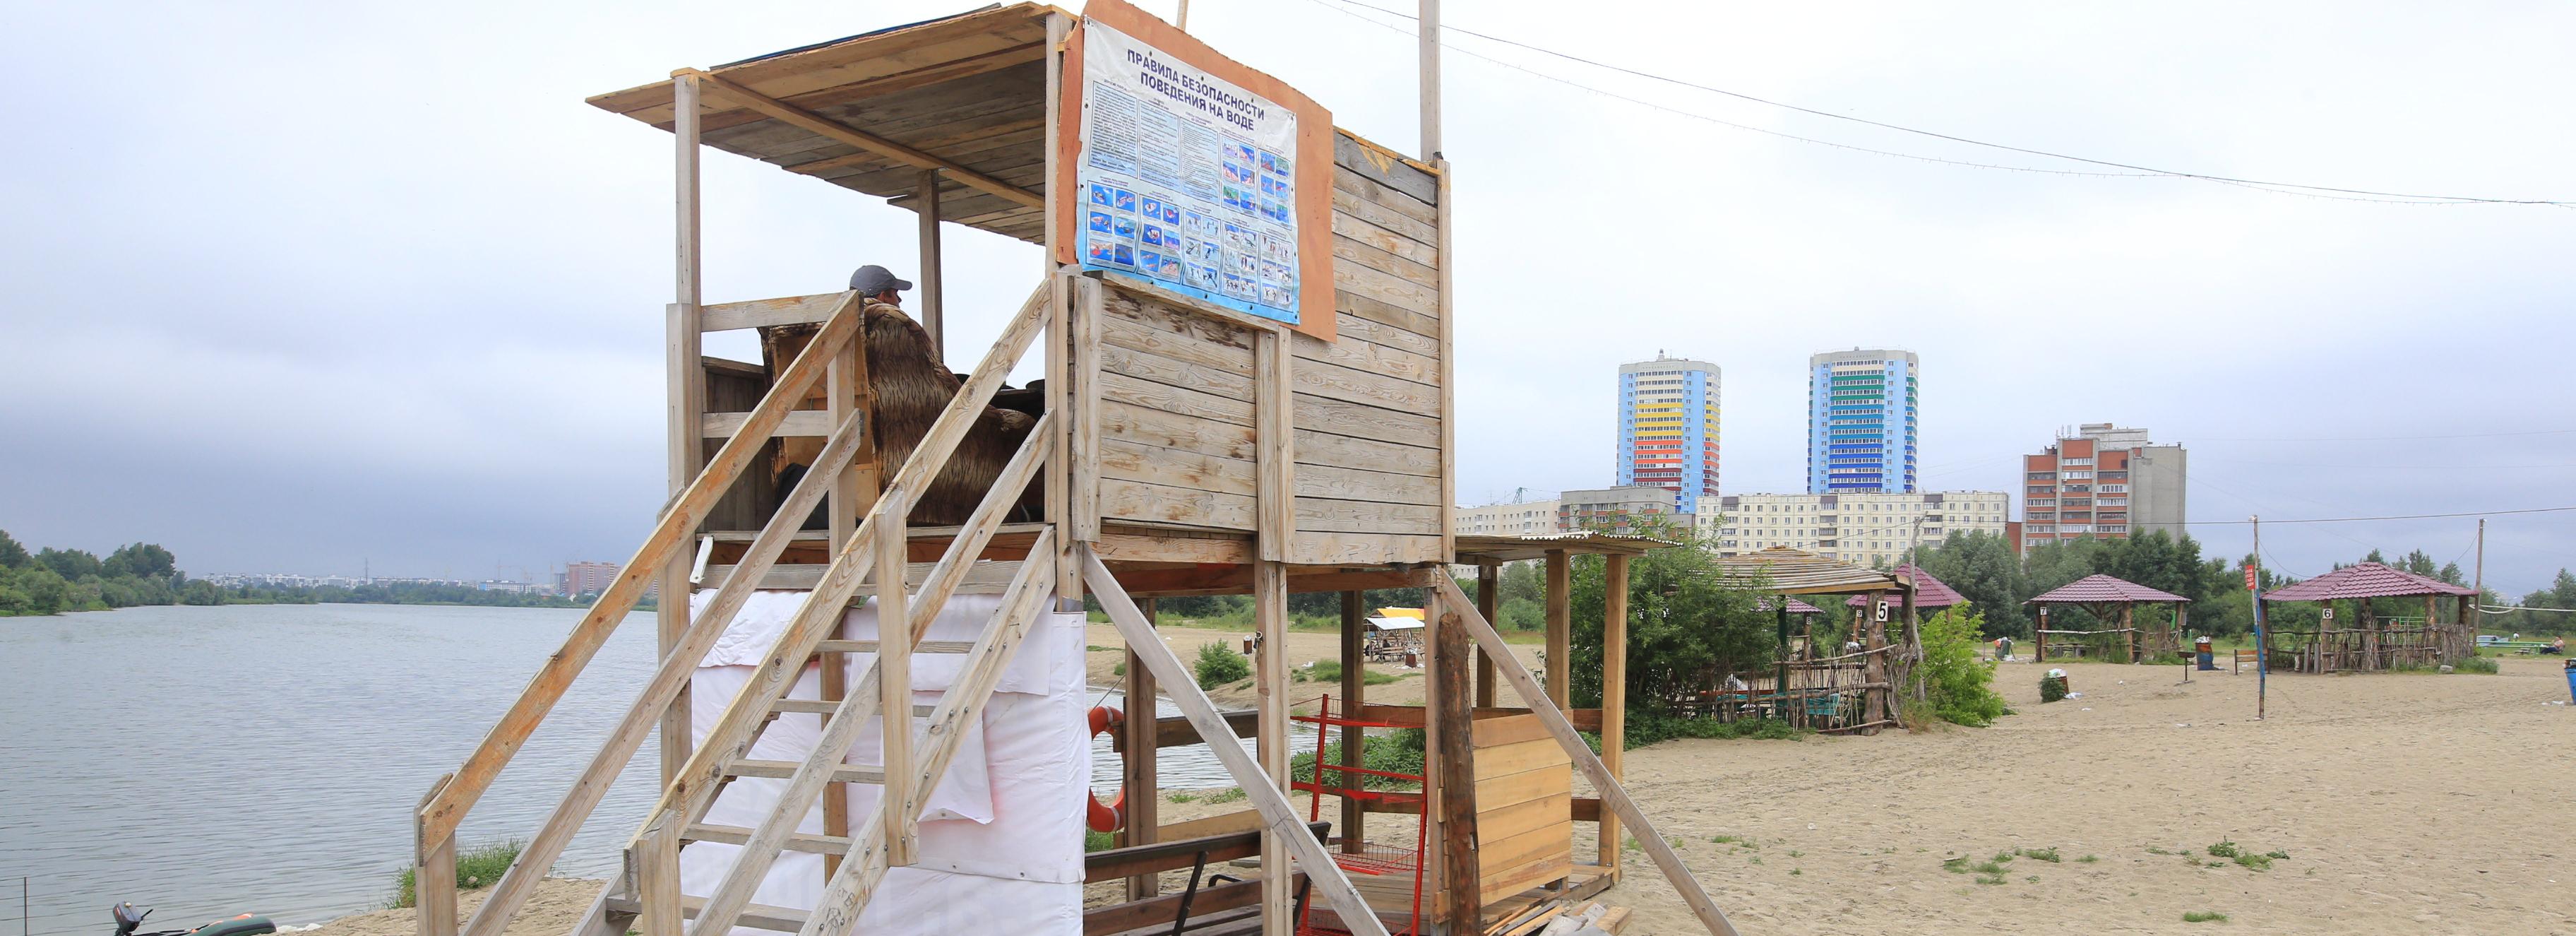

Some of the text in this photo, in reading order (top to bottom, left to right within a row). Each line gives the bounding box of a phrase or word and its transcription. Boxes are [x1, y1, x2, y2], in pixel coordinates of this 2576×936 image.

[1127, 49, 1265, 120] ПРАВИЛА БЕЗОПАСНОСТИ
[1140, 72, 1206, 111] ПОВЕДЕНИЯ
[1209, 102, 1224, 119] НА
[1227, 109, 1254, 131] ВОДЕ
[1878, 603, 1886, 620] 5
[2324, 609, 2331, 618] 6
